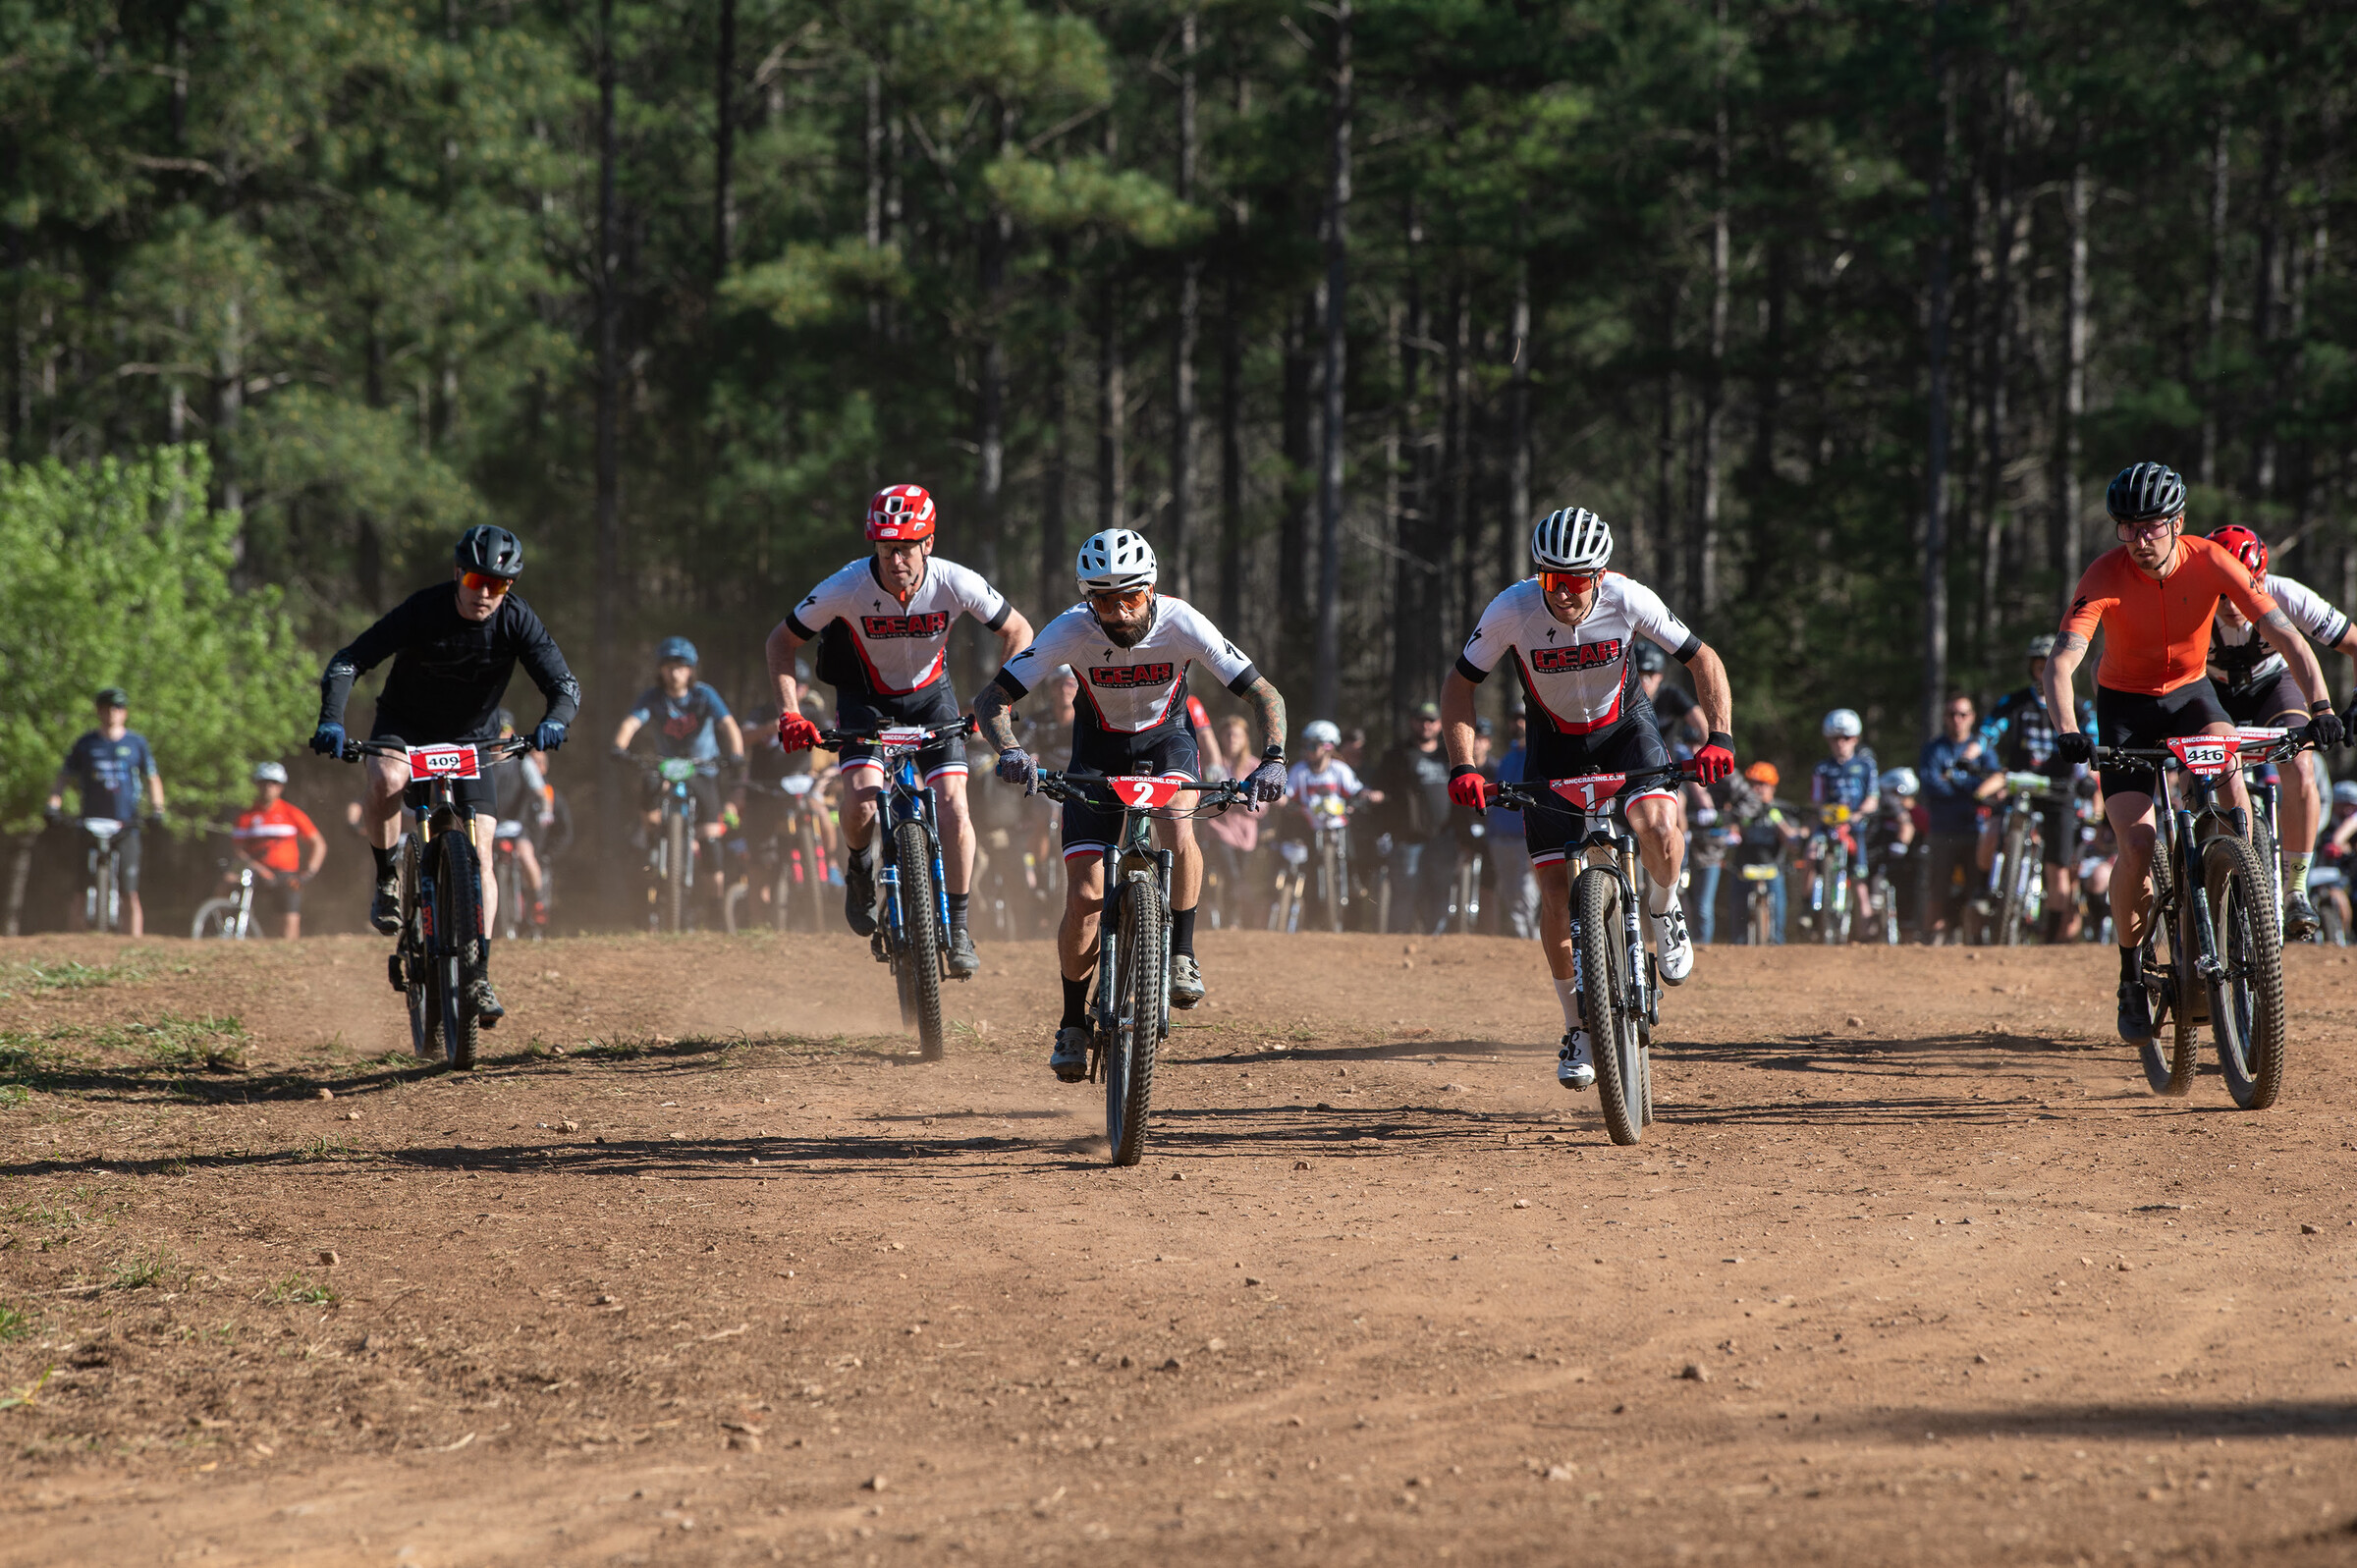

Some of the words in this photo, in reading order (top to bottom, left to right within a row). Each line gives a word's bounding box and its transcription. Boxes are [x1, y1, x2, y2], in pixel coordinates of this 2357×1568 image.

[865, 612, 946, 634] GEAR
[1535, 640, 1619, 669] GEAR
[1093, 664, 1170, 683] GEAR
[2181, 734, 2241, 743] GNCCRACING.COM
[428, 756, 459, 767] 409
[2187, 749, 2223, 761] 416
[1563, 775, 1625, 784] GNCCRACING.COM
[1133, 782, 1154, 808] 2
[1580, 783, 1596, 810] 1
